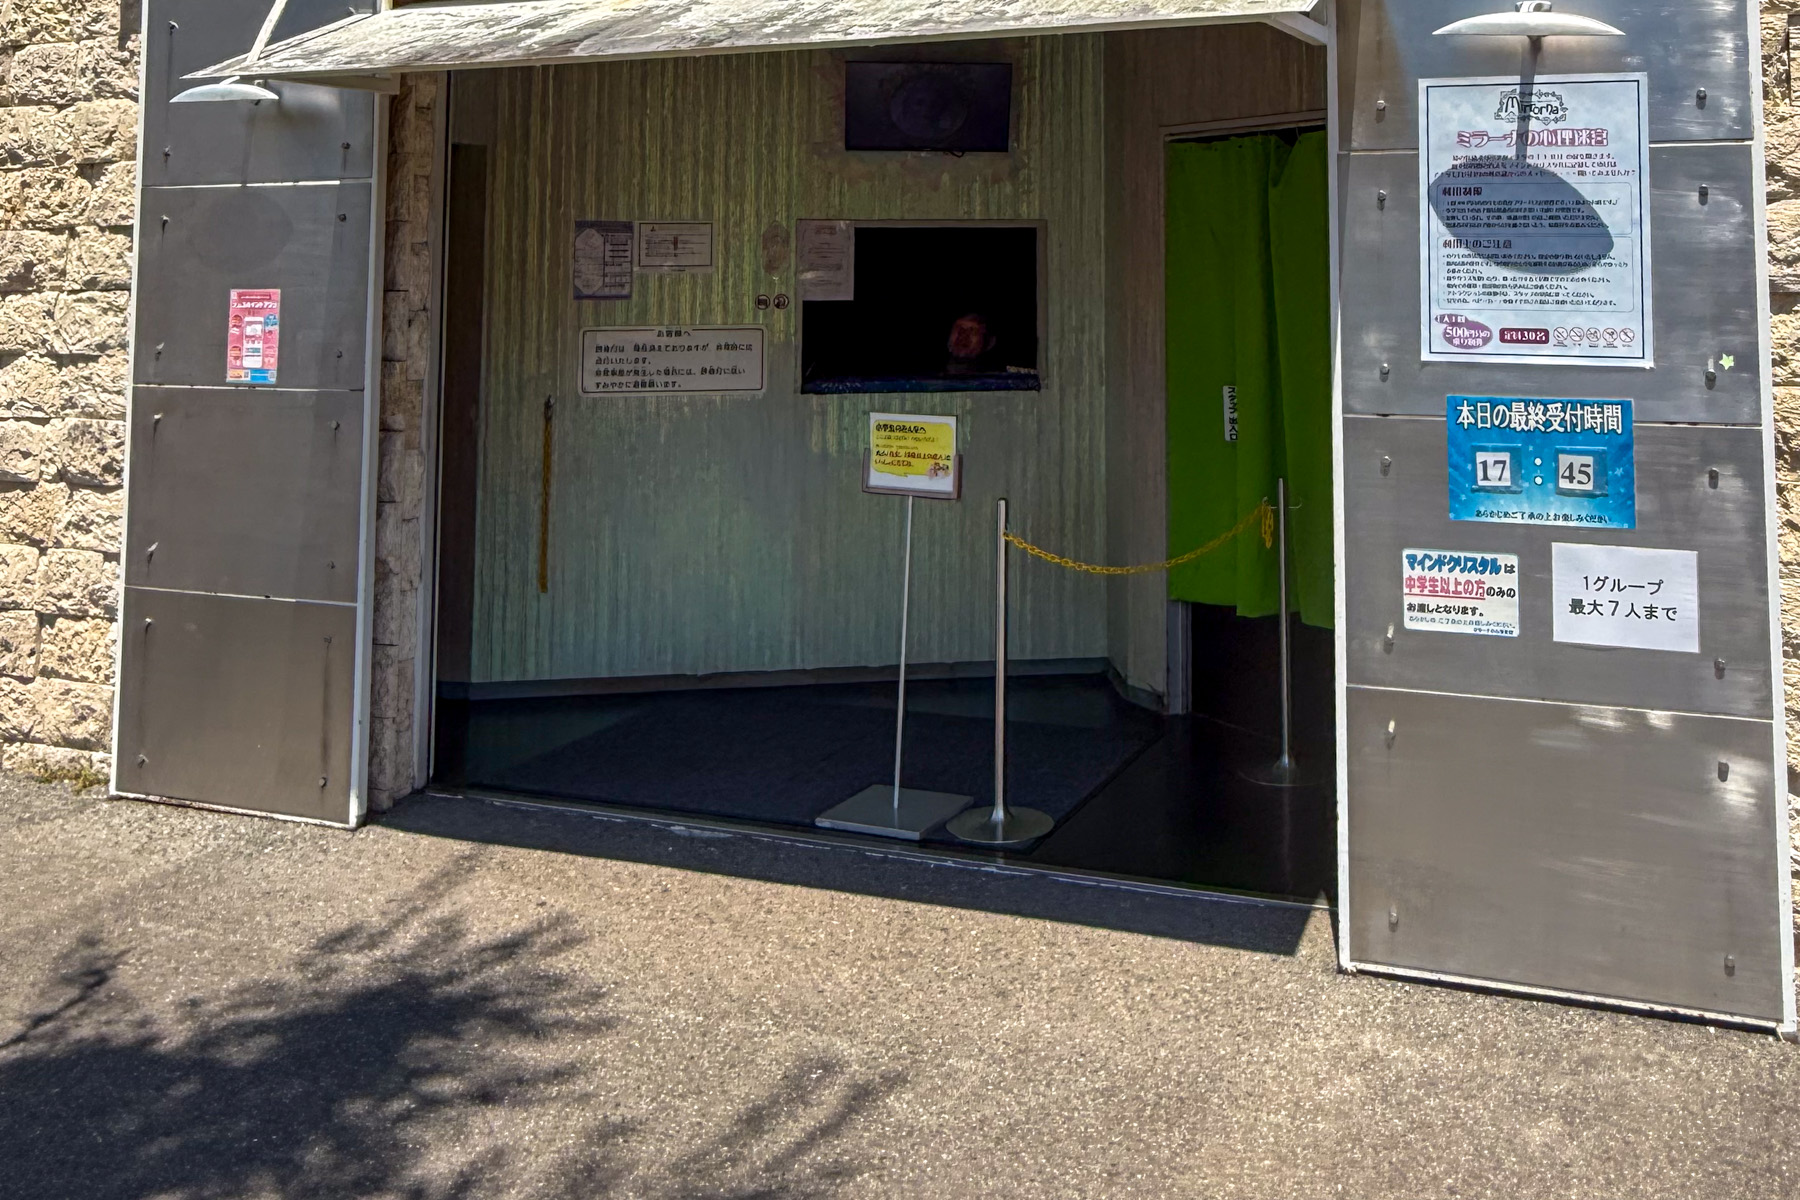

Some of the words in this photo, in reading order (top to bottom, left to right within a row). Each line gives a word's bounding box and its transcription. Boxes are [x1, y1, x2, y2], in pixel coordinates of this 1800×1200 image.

[1456, 401, 1623, 434] 本日の最終受付時間
[1478, 459, 1507, 482] 17
[1560, 462, 1592, 485] 45
[1405, 553, 1516, 575] マインドクリスタルは
[1405, 575, 1516, 599] 中学生以上の方のみの
[1583, 575, 1664, 596] 1グループ
[1568, 598, 1678, 622] 最大7人まで
